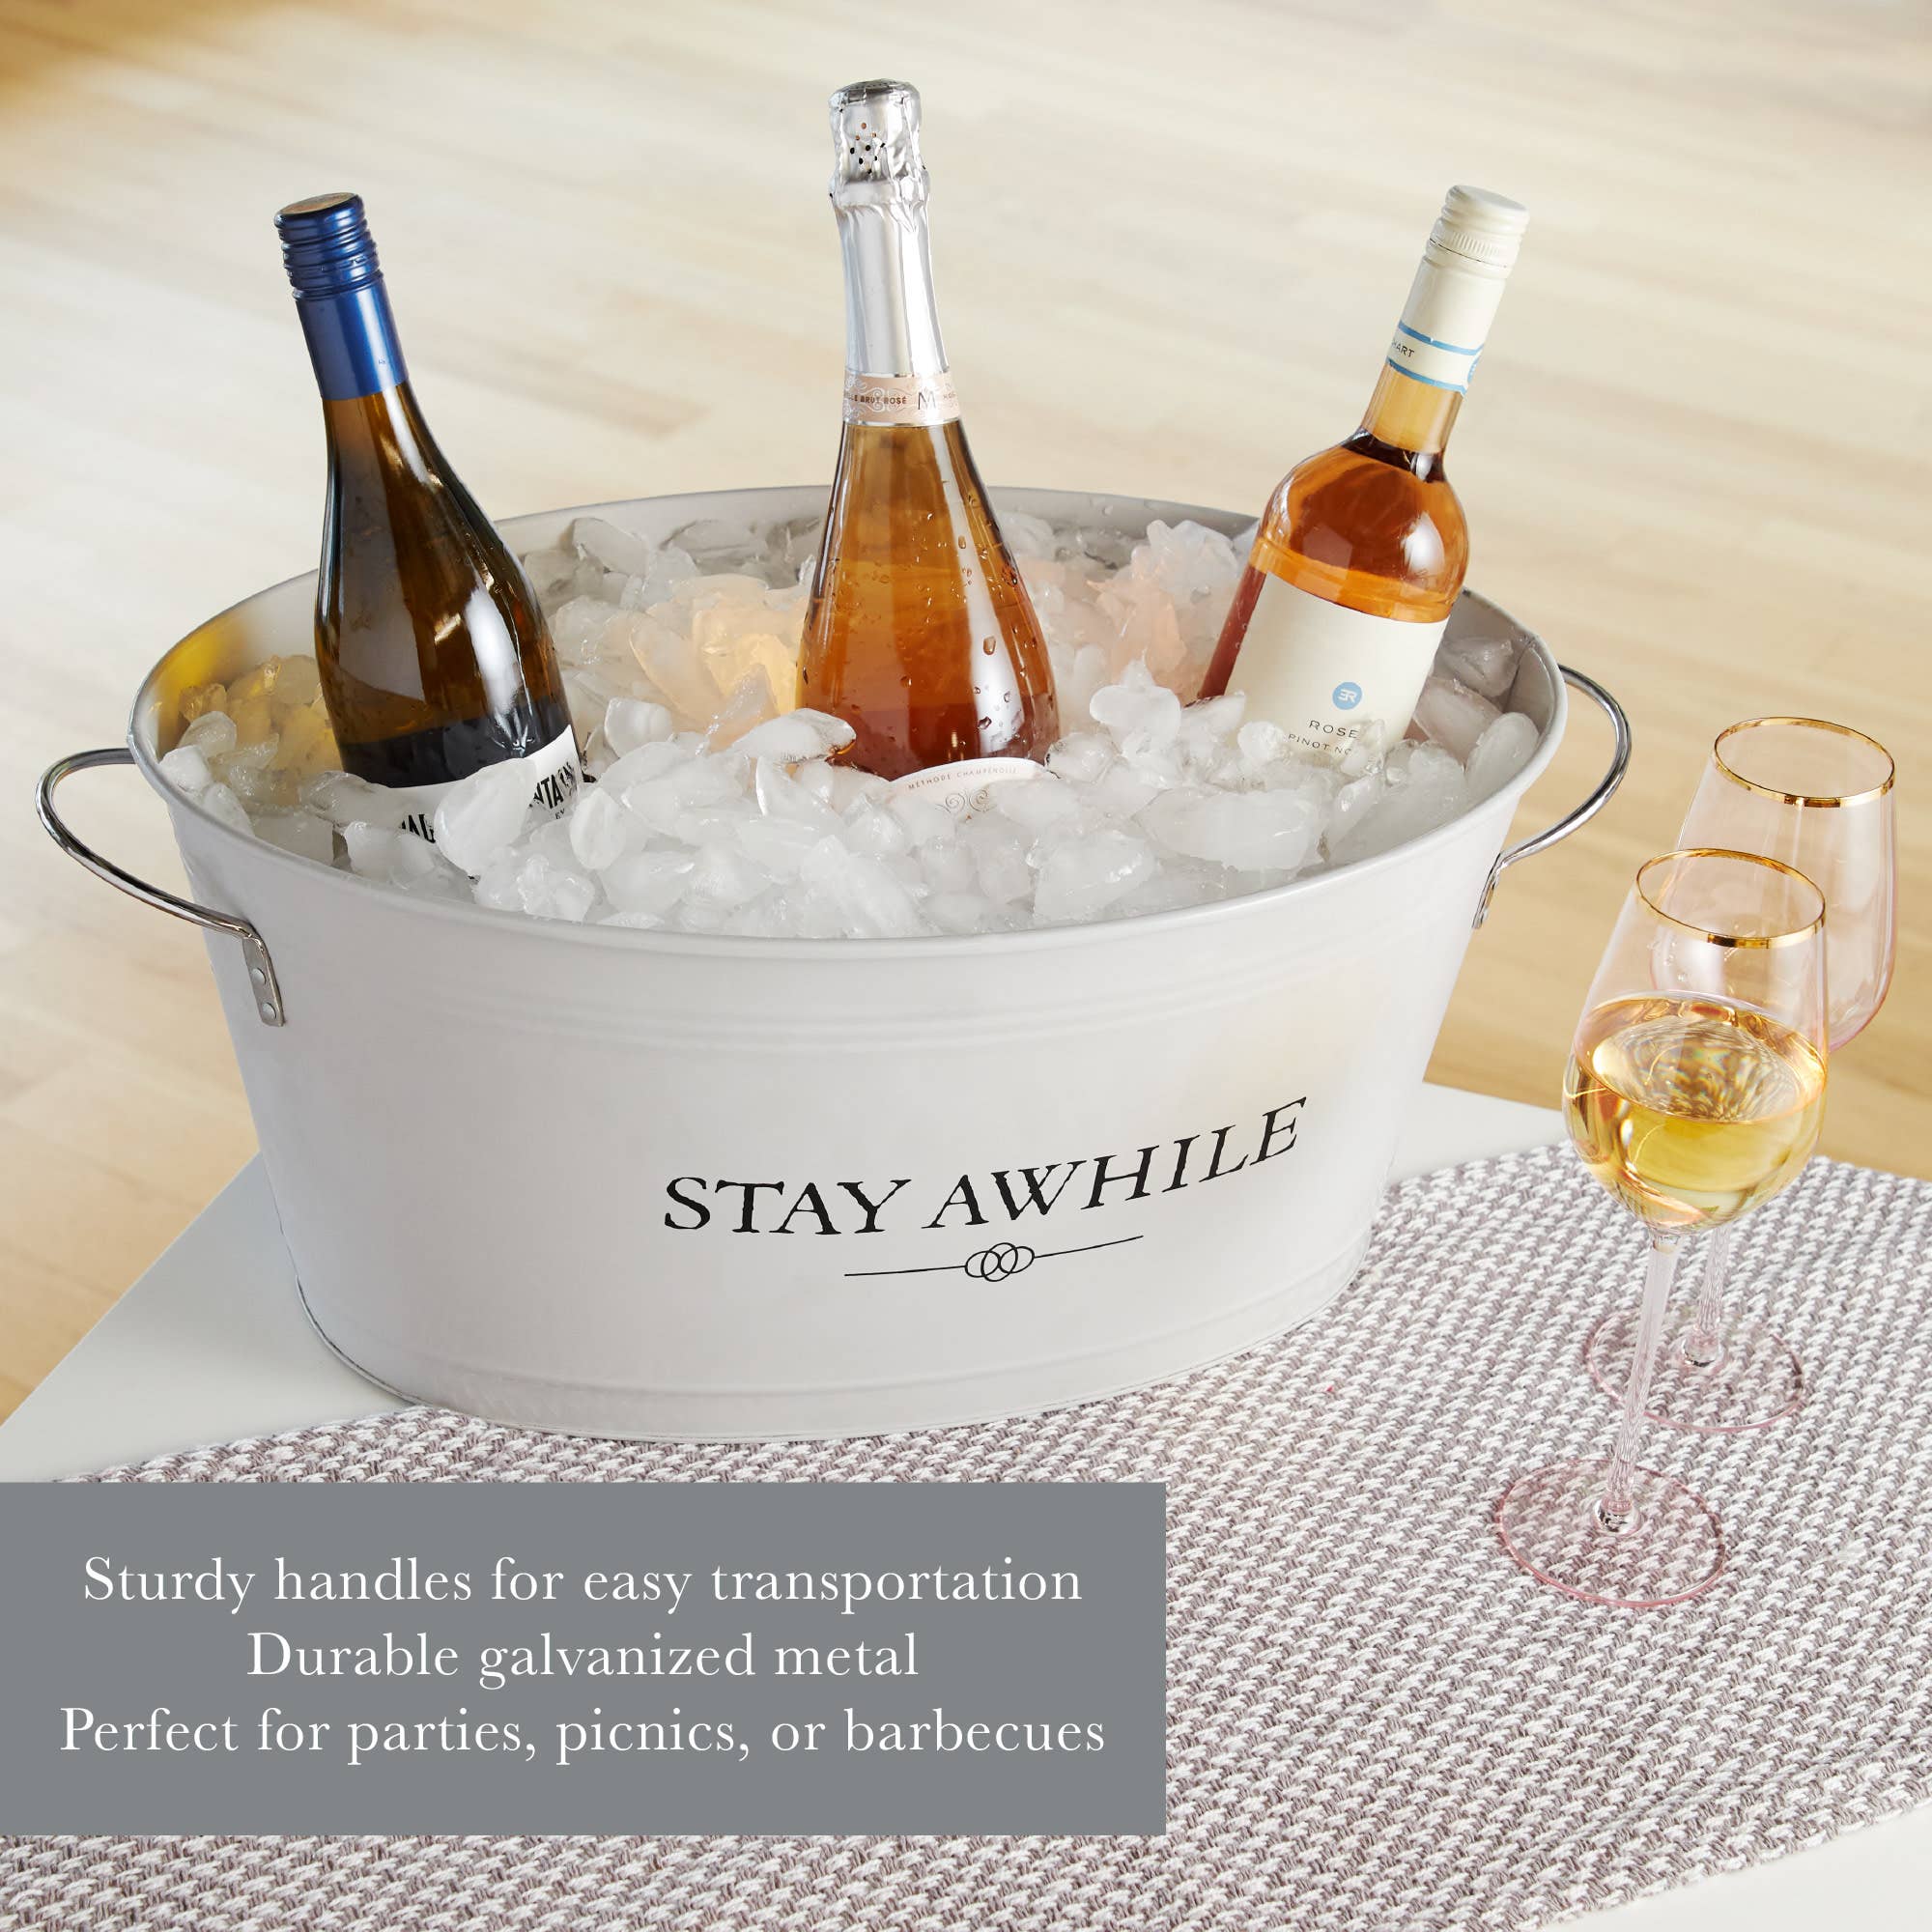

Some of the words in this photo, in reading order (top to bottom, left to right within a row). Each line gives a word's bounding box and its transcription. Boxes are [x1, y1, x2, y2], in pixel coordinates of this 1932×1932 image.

[1288, 733, 1331, 752] PINOT
[664, 1177, 913, 1236] STAY
[921, 1096, 1307, 1230] AWHILE
